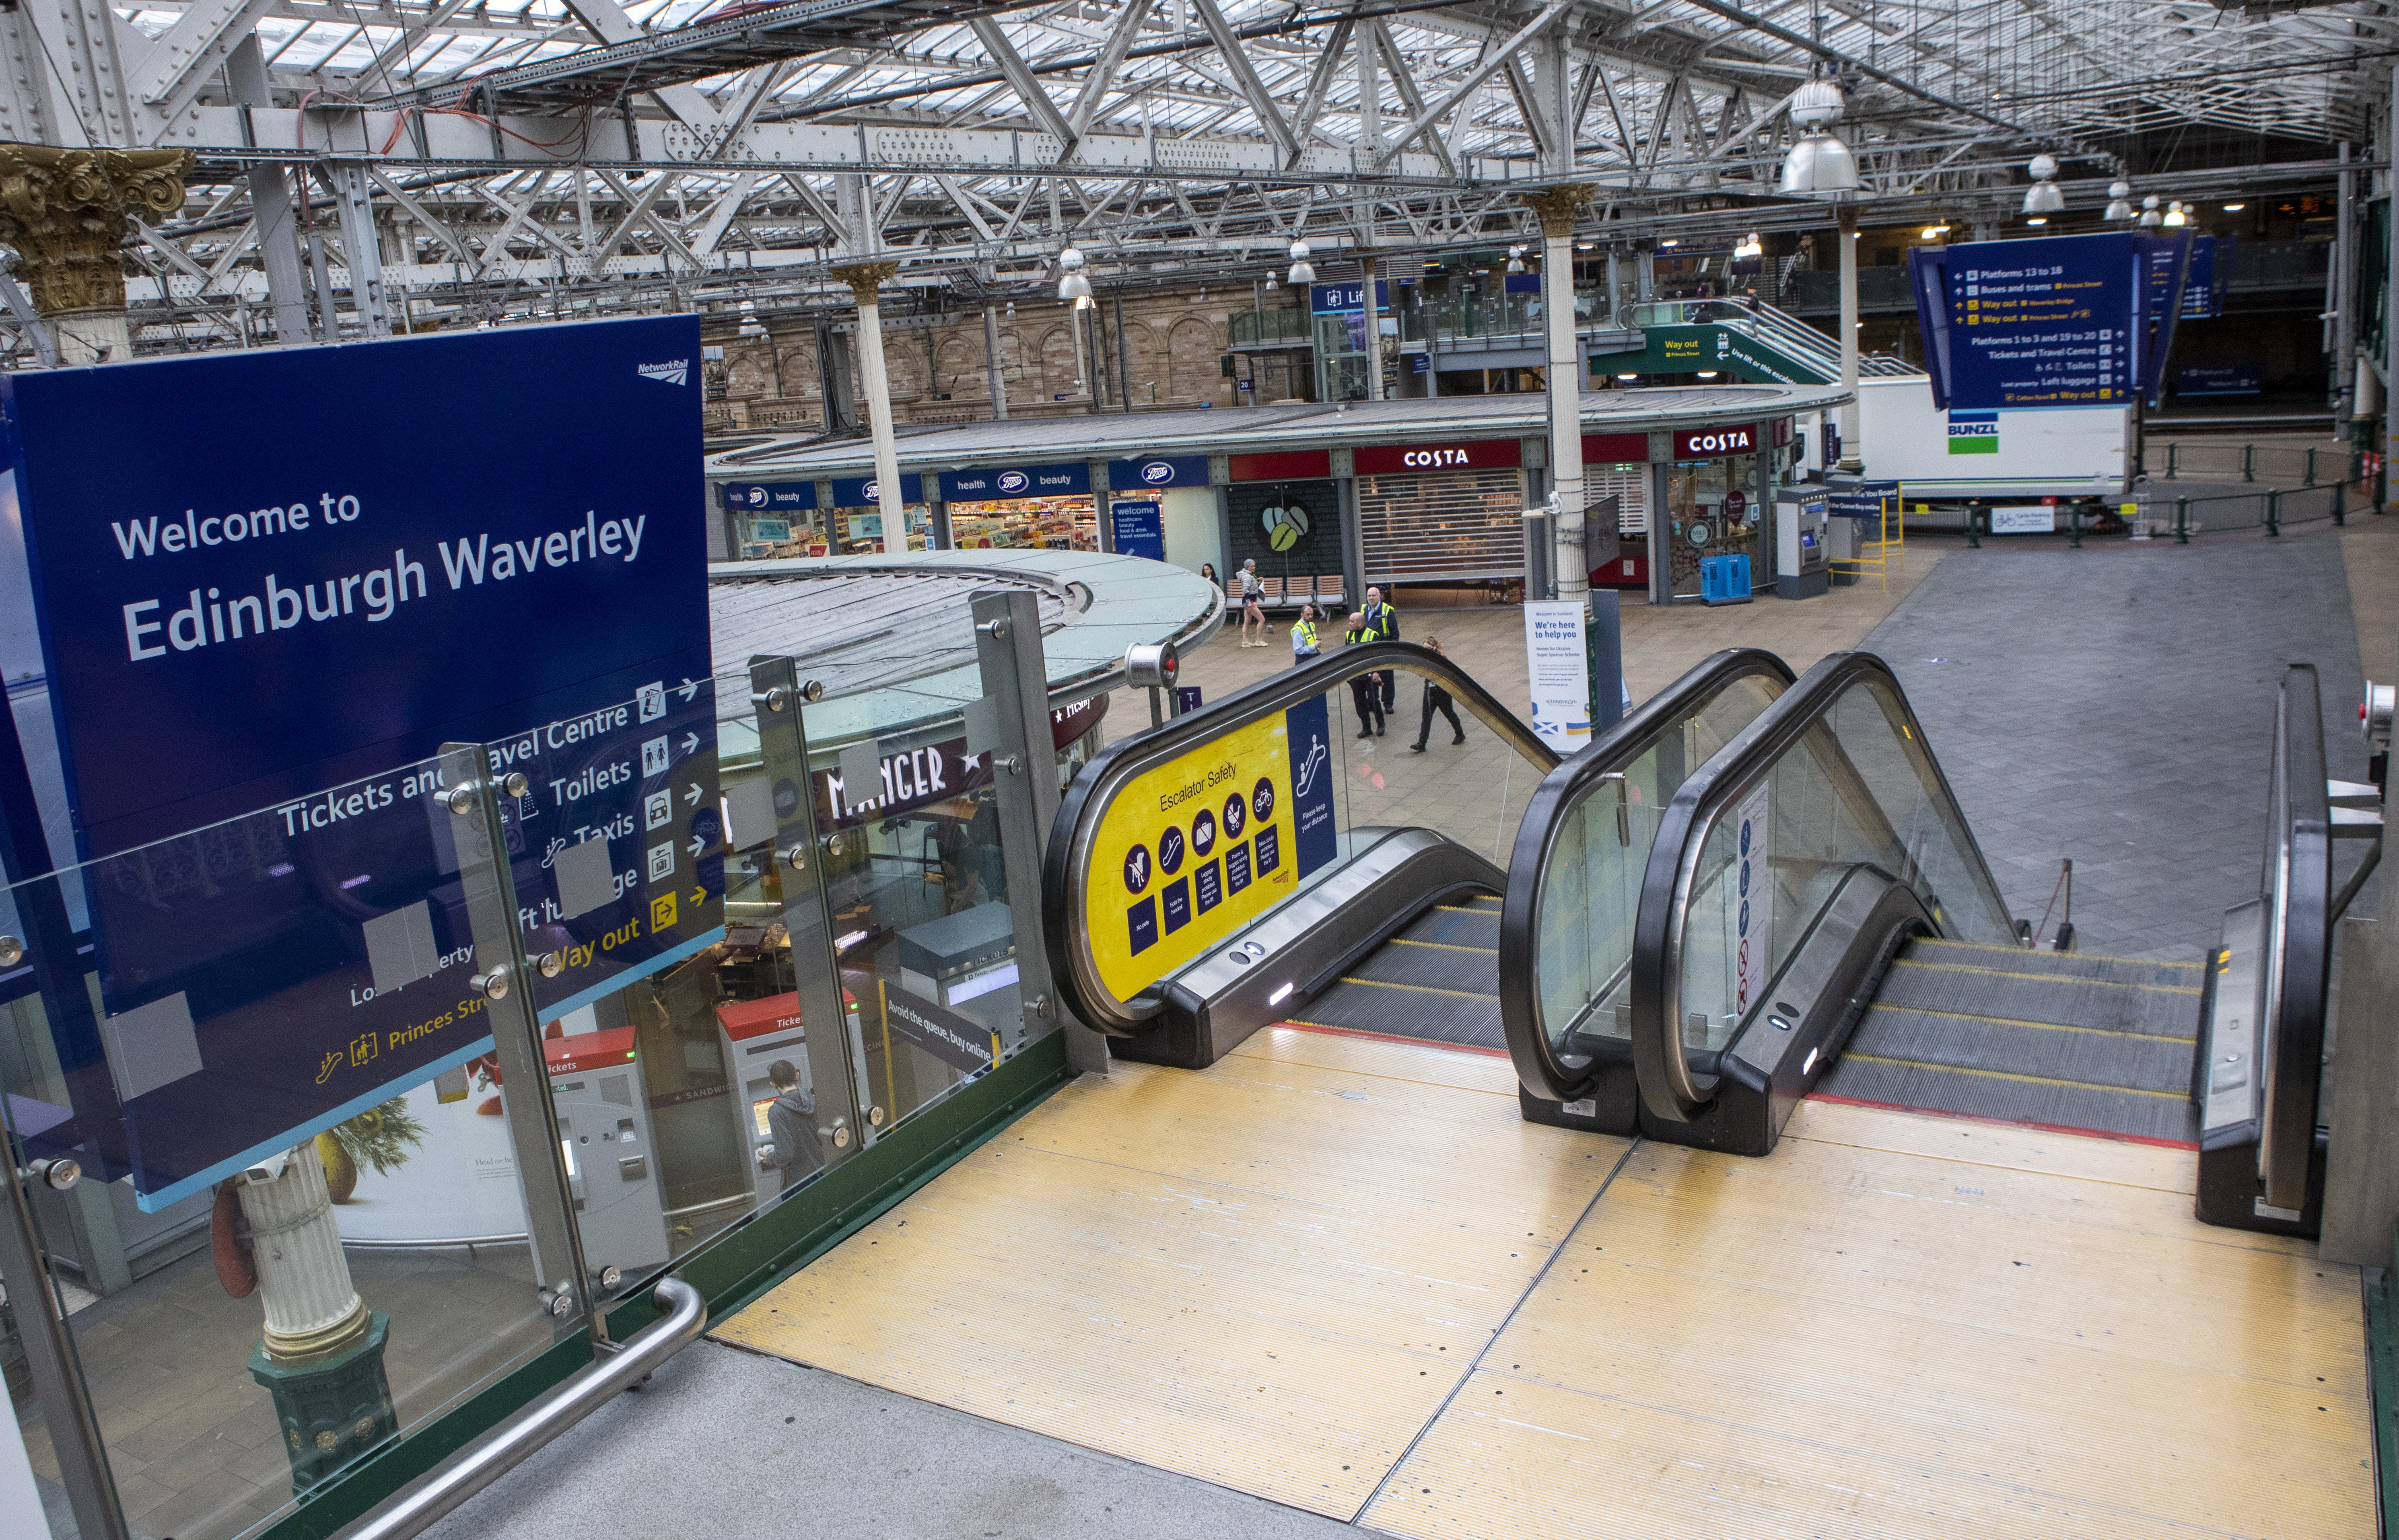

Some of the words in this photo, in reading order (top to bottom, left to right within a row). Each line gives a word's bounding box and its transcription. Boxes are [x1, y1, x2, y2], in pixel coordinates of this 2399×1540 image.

[1980, 269, 2023, 279] Platforms
[2025, 267, 2037, 277] 13
[2051, 266, 2063, 275] 18
[1981, 285, 2006, 294] Buses
[2008, 283, 2024, 292] and
[2026, 284, 2052, 292] trams
[1349, 290, 1363, 303] Lif
[1982, 300, 2001, 309] Way
[1982, 315, 2001, 324] Way
[1971, 337, 2012, 345] Platforms
[2014, 334, 2019, 343] 1
[2021, 335, 2031, 343] to
[2033, 334, 2039, 343] 3
[2040, 333, 2057, 342] and
[2059, 333, 2070, 341] 19
[2084, 331, 2096, 339] 20
[1665, 341, 1682, 350] Way
[1988, 351, 2018, 360] Tickets
[2020, 350, 2037, 358] and
[2039, 348, 2065, 357] Travel
[2066, 347, 2096, 356] Centre
[638, 359, 688, 374] NetworkRail
[1732, 348, 1743, 359] Use
[1743, 354, 1753, 364] lift
[1760, 364, 1772, 374] this
[2066, 362, 2096, 370] Toilets
[2061, 377, 2096, 386] luggage
[2060, 391, 2079, 400] Way
[1948, 425, 1999, 435] BUNZL
[1689, 432, 1749, 452] COSTA
[1404, 449, 1468, 467] COSTA
[1147, 467, 1168, 480] Boots
[958, 480, 985, 490] health
[1002, 476, 1022, 489] Boots
[1040, 475, 1071, 486] beauty
[730, 493, 743, 502] health
[776, 493, 799, 502] beauty
[1878, 488, 1897, 496] Board
[1118, 506, 1154, 516] welcome
[113, 502, 310, 559] Welcome
[320, 493, 360, 524] to
[122, 548, 427, 661] Edinburgh
[439, 510, 646, 590] Waverley
[1545, 630, 1561, 640] help
[1563, 632, 1576, 640] you
[278, 781, 393, 837] Tickets
[490, 728, 539, 771] avel
[546, 705, 628, 749] Centre
[549, 759, 631, 806] Toilets
[1160, 779, 1205, 812] Escalator
[1208, 763, 1236, 787] Safety
[1303, 809, 1316, 820] Please
[1316, 803, 1326, 812] keep
[1302, 822, 1312, 833] your
[1312, 812, 1328, 826] distance
[1266, 835, 1275, 843] strictly
[1228, 860, 1239, 869] buggies
[1239, 855, 1248, 863] strictly
[1231, 851, 1241, 860] Prams
[1260, 852, 1269, 861] Please
[1201, 868, 1213, 878] Luggage
[1231, 873, 1241, 882] Please
[1272, 869, 1289, 882] NetworkRail
[1203, 876, 1213, 884] strictly
[1201, 891, 1211, 901] Please
[1171, 904, 1183, 915] handrail
[601, 915, 640, 952] out
[974, 949, 1008, 966] Tickets
[389, 1010, 453, 1050] Princes
[888, 999, 909, 1020] Avoid
[910, 1010, 923, 1026] the
[924, 1019, 950, 1042] queue,
[950, 1028, 966, 1053] buy
[966, 1041, 992, 1062] online
[548, 1062, 577, 1073] ickets
